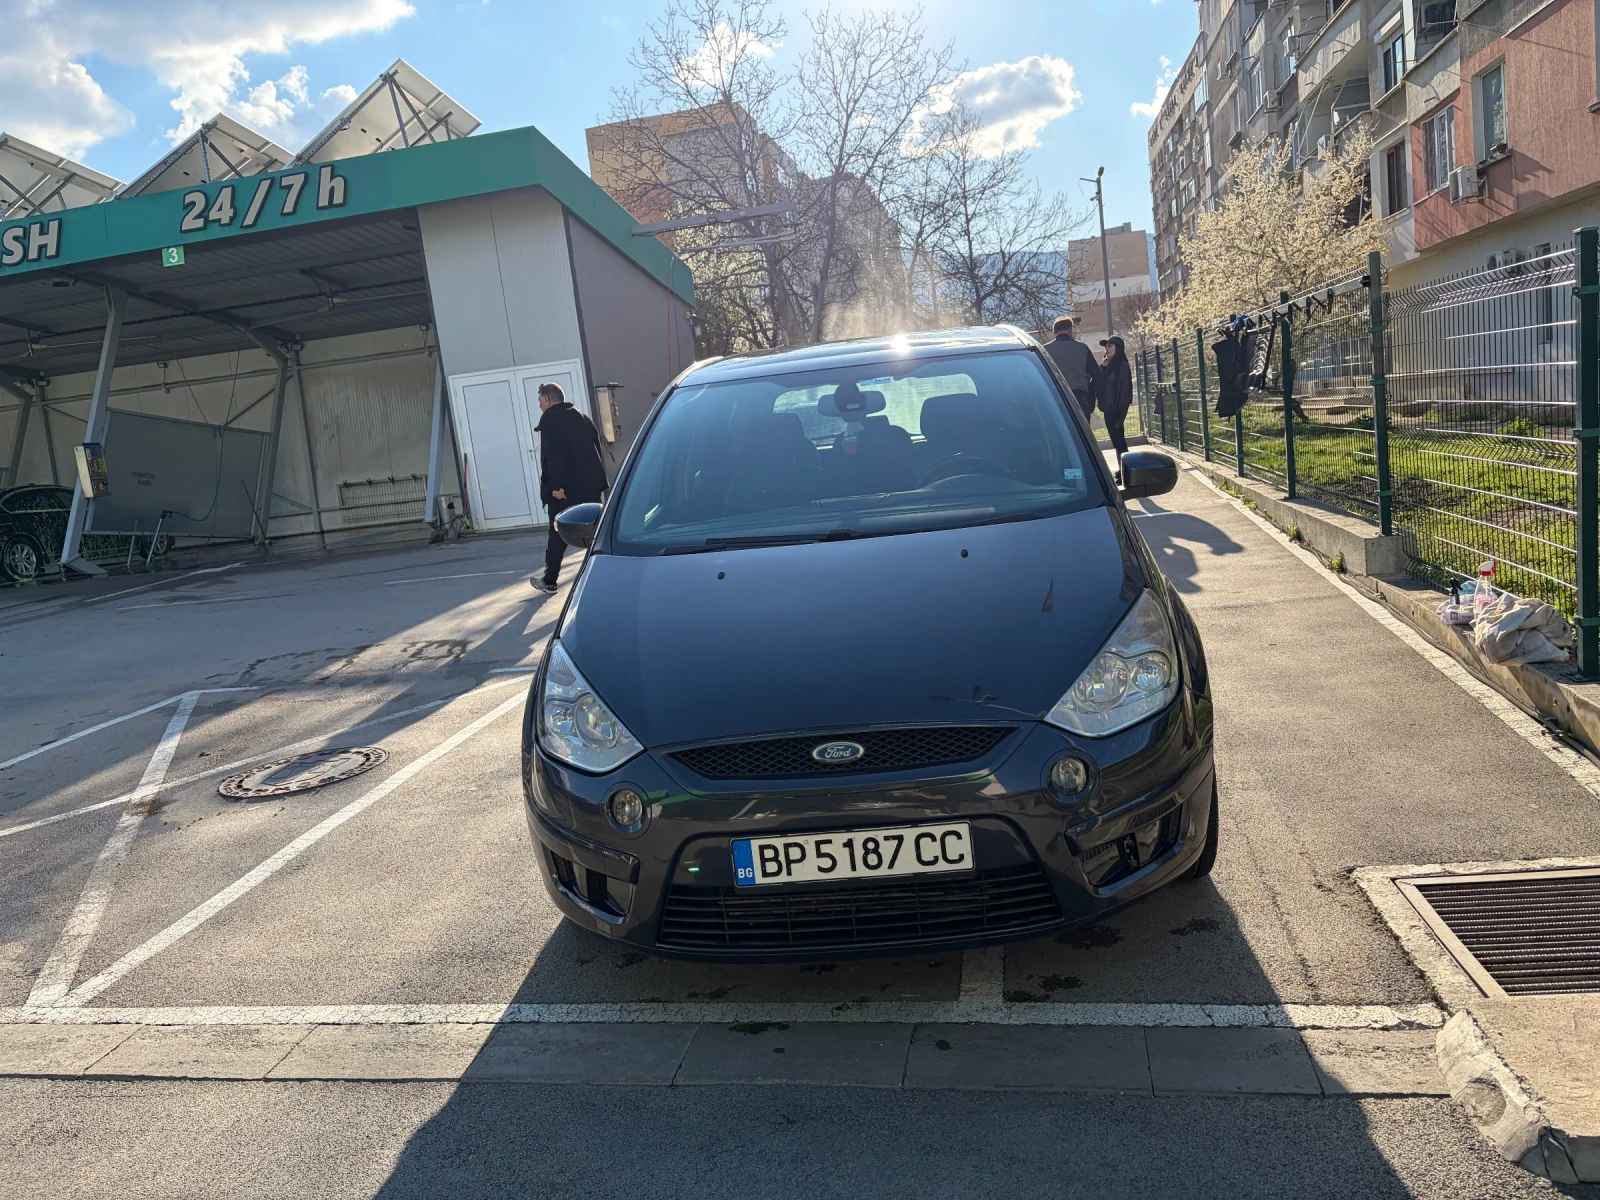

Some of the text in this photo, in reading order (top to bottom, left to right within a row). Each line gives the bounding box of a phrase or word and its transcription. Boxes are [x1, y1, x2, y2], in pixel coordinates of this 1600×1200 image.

[1, 164, 347, 266] SH 24/7 h
[168, 247, 179, 263] 3
[825, 746, 852, 758] Ford
[758, 829, 965, 878] BP 5187 CC
[737, 868, 753, 879] BG
